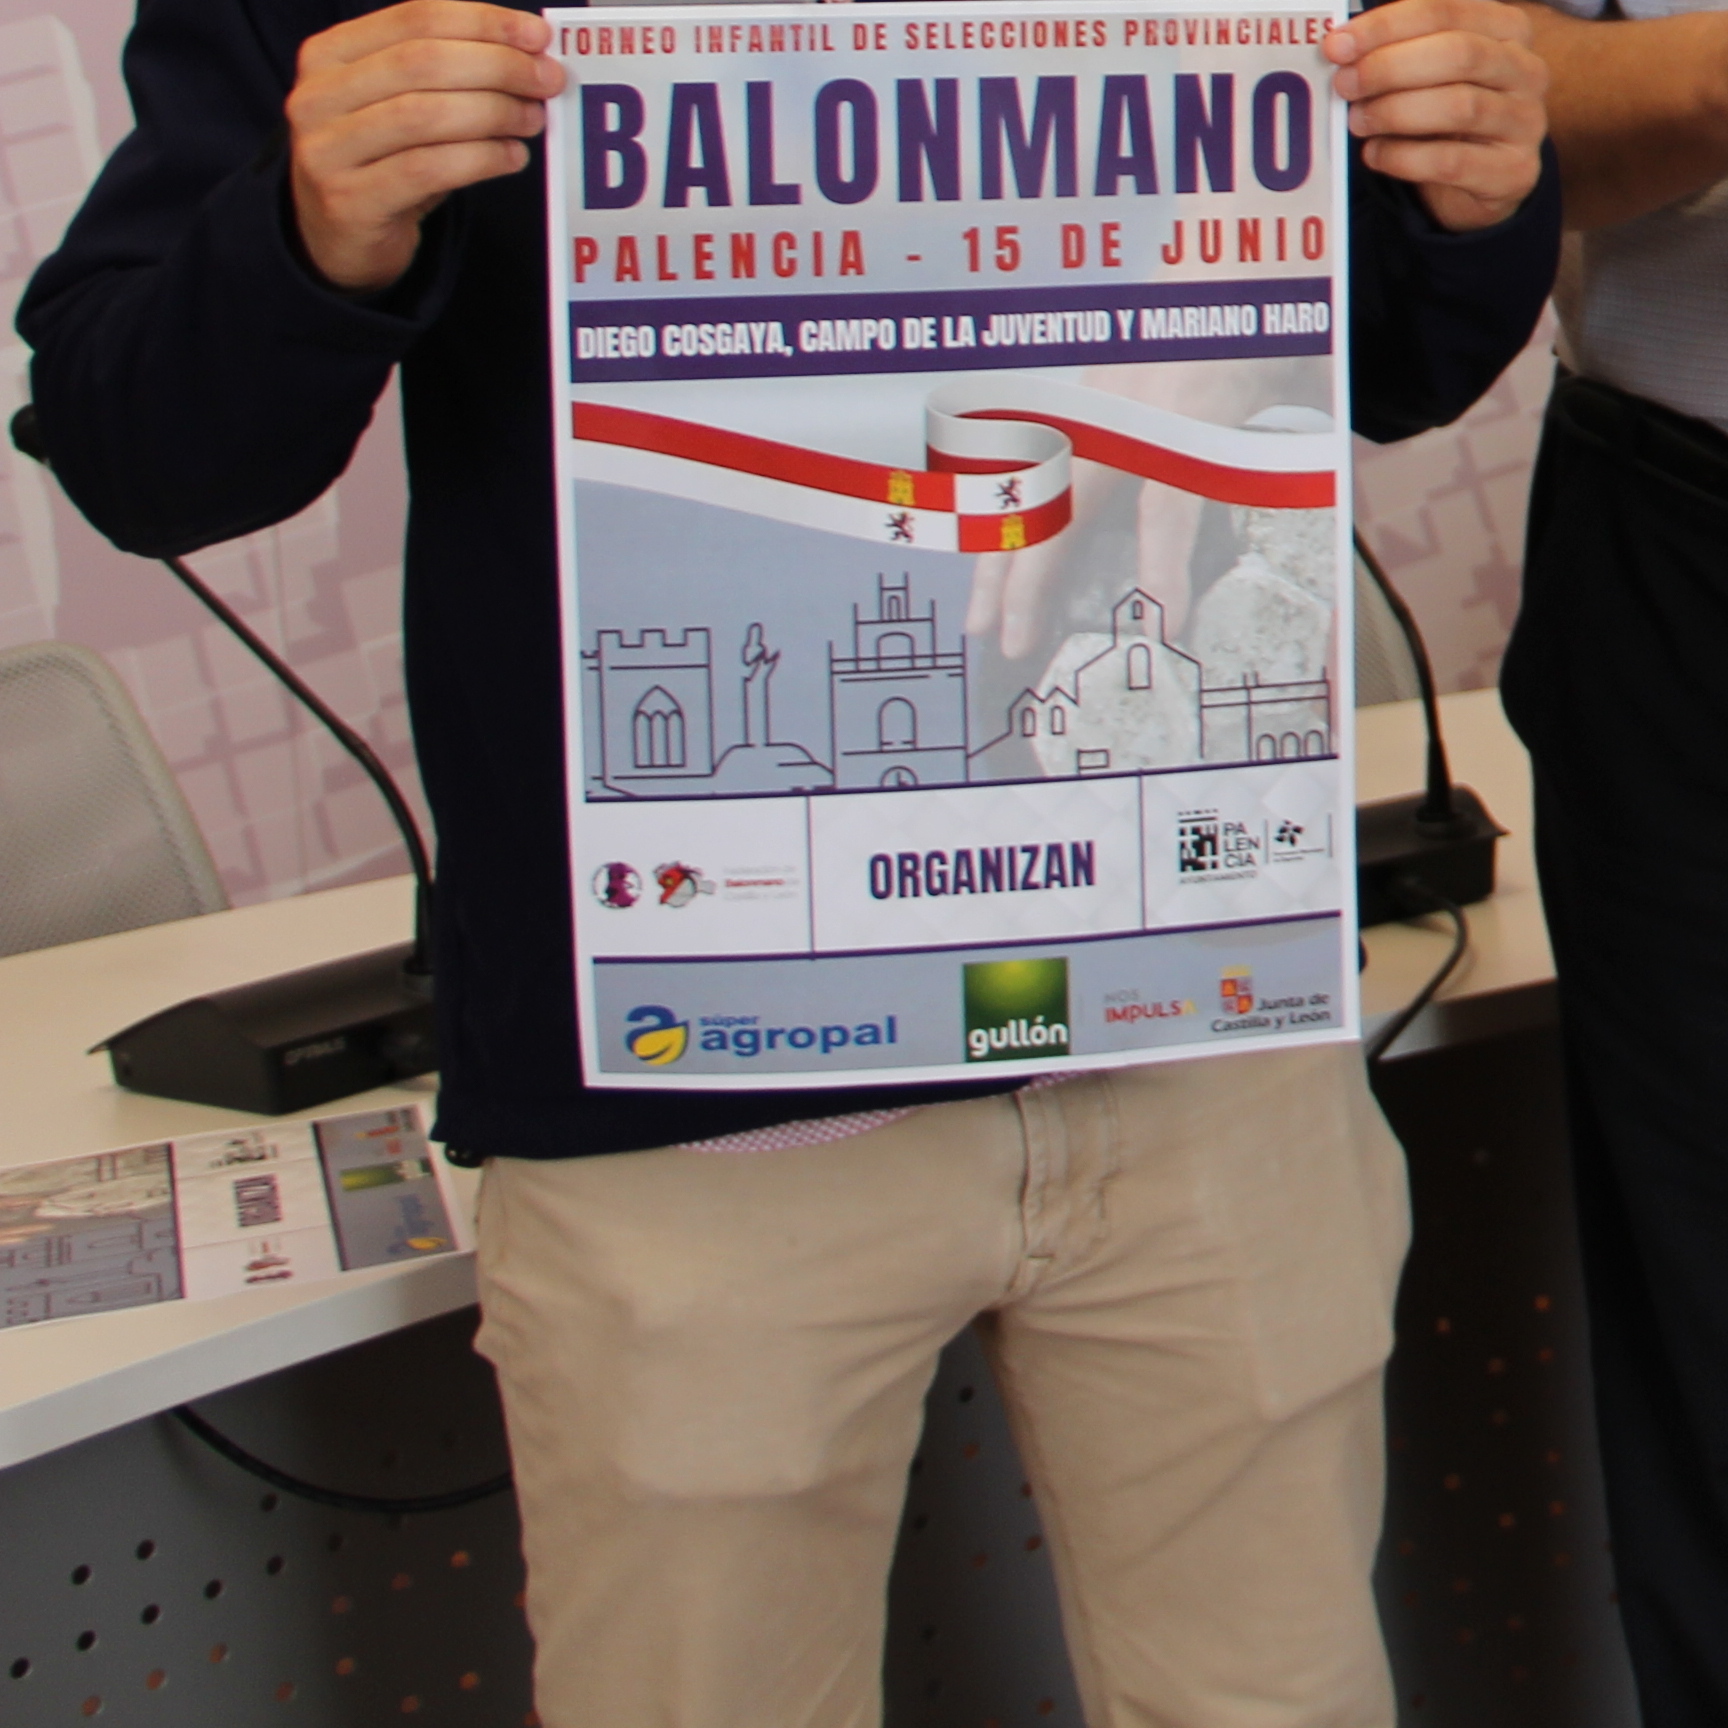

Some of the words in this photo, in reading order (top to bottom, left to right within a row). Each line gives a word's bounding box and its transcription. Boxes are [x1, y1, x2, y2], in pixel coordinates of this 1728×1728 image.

[696, 23, 835, 54] INFANTIL
[853, 22, 887, 51] DE
[906, 20, 1107, 50] SELECCIONES
[580, 70, 1313, 210] BALONMANO
[573, 230, 866, 283] PALENCIA
[962, 225, 1020, 273] 15
[1061, 222, 1121, 269] DE
[1161, 216, 1325, 265] JUNIO
[577, 325, 655, 359] DIEGO
[661, 321, 793, 357] COSGAYA,
[800, 318, 896, 352] CAMPO
[903, 316, 936, 350] DE
[943, 316, 975, 348] LA
[982, 309, 1111, 346] JUVENTUD
[1117, 309, 1136, 340] Y
[1140, 304, 1257, 339] MARIANO
[1263, 301, 1329, 335] HARO
[1223, 822, 1247, 836] PA
[1224, 836, 1260, 852] LEN
[868, 839, 1095, 900] ORGANIZAN
[1225, 852, 1256, 868] CIA
[1259, 997, 1305, 1010] Junta
[1310, 992, 1330, 1005] de
[700, 1015, 898, 1057] agropal
[969, 1016, 1068, 1056] gullón
[1211, 1017, 1270, 1033] Castilla
[1274, 1016, 1283, 1029] y
[1289, 1009, 1331, 1024] León
